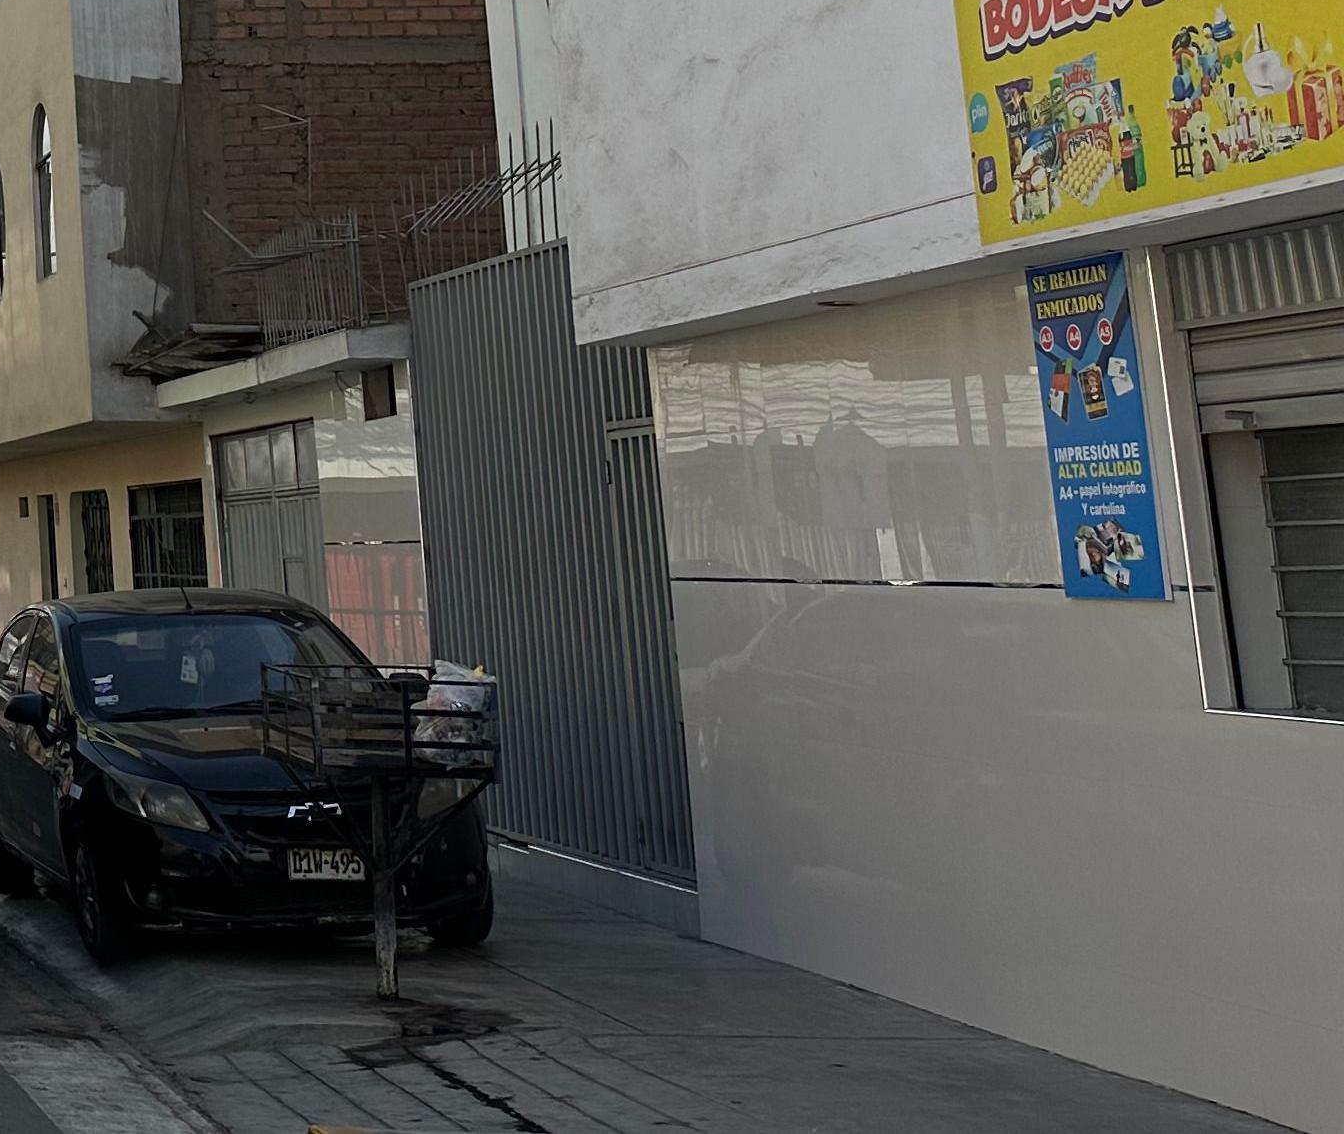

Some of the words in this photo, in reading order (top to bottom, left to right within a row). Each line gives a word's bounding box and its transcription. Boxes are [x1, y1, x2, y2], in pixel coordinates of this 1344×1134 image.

[1032, 275, 1047, 293] SE
[1048, 264, 1107, 291] REALIZAN
[1035, 292, 1105, 320] ENMICADOS
[1053, 441, 1120, 463] IMPRESIÓN
[1122, 442, 1140, 458] DE
[1057, 463, 1088, 479] ALTA
[1089, 460, 1143, 478] CALIDAD
[1081, 502, 1088, 516] Y
[1089, 501, 1126, 516] cartulina
